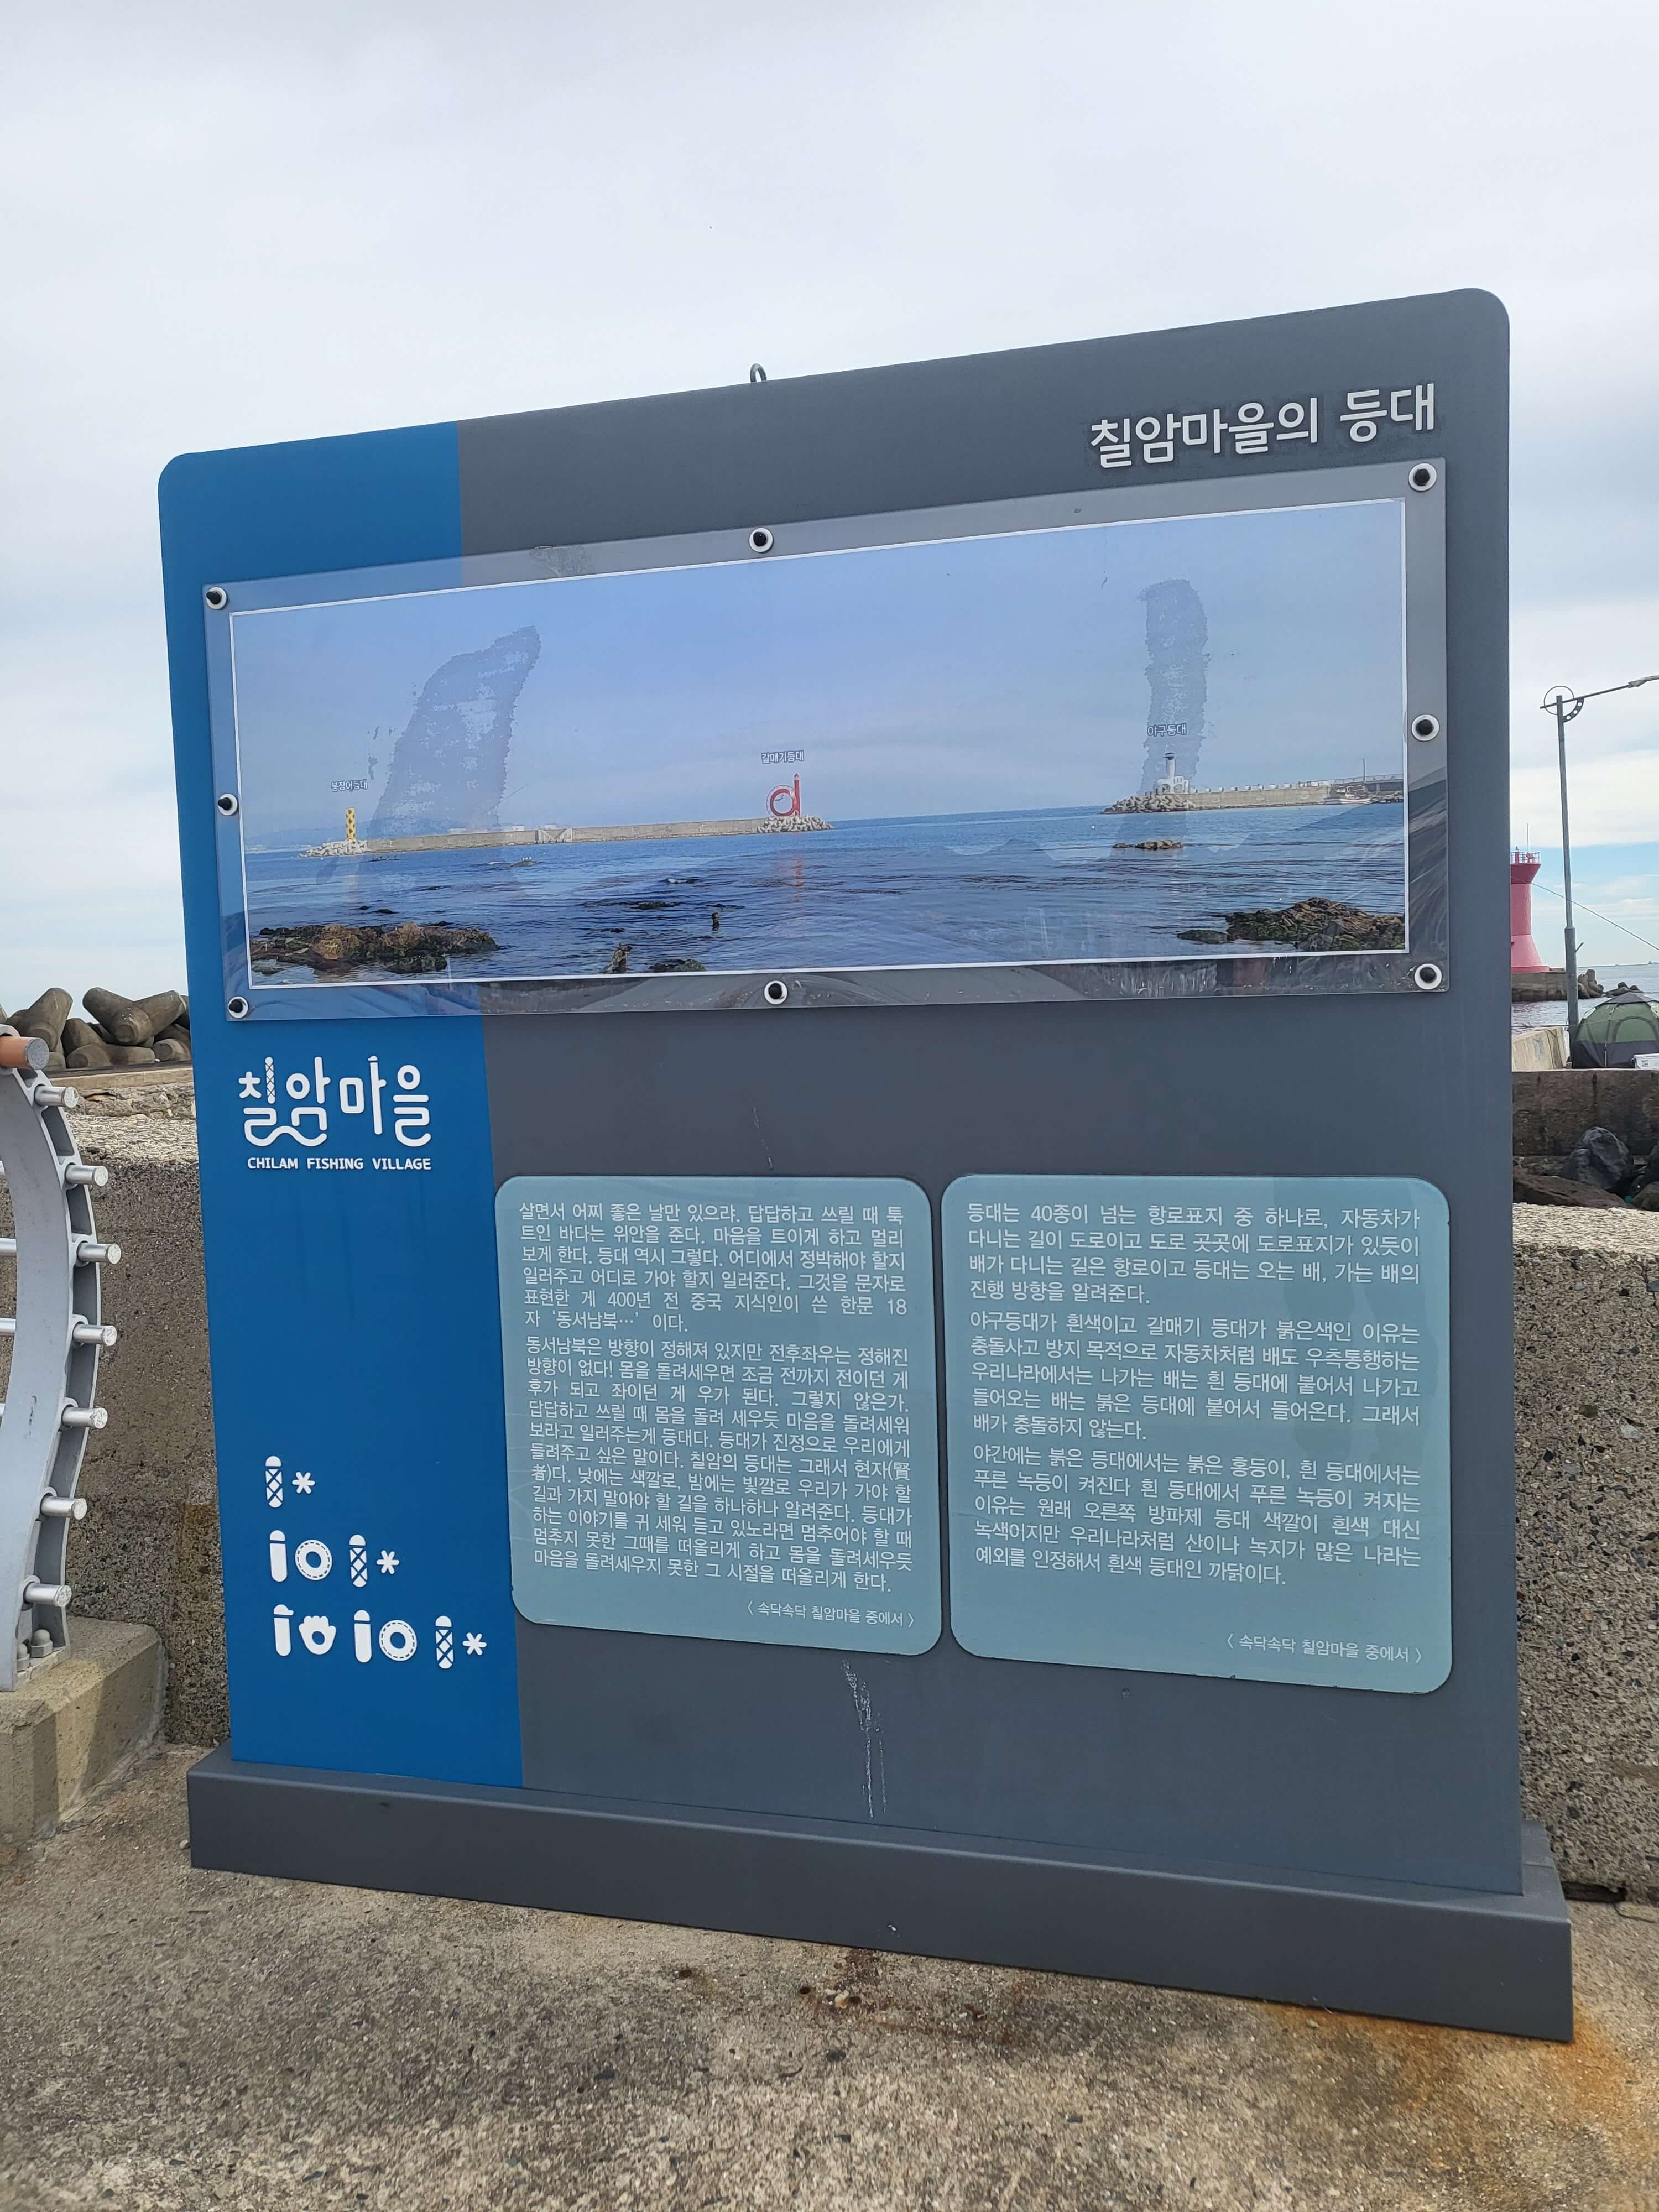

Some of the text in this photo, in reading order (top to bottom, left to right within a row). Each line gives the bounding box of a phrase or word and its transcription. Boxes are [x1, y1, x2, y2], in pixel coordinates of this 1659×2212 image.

[1091, 383, 1435, 469] 칠암마을의 등대
[1147, 723, 1187, 737] 야구등대
[761, 750, 805, 764] 갈매기등대
[239, 1055, 432, 1147] 칠암마을
[247, 1157, 432, 1171] CHILAM FISHING VILLAGE
[519, 1202, 904, 1225] 살면서 어찌 좋은 날만 있으랴. 답답하고 쓰릴 때 툭
[967, 1203, 1420, 1229] 등대는 40종이 넘는 항로표지 중 하나로, 자동차가
[521, 1245, 905, 1271] 보게 한다. 등대 역시 그렇다. 어디에서 정박해야 할지
[968, 1228, 1418, 1257] 다니는 길이 도로이고 도로 곳곳에 도로표지가 있듯이
[523, 1266, 906, 1293] 일러주고 어디로 가야 할지 일러준다. 그것을 문자로
[969, 1254, 1418, 1284] 배가 다니는 길은 항로이고 등대는 오는 배, 가는 배의
[970, 1280, 1150, 1304] 진행 방향을 알려준다.
[970, 1310, 1420, 1344] 야구등대가 흰색이고 갈매기 등대가 붉은색인 이유는
[525, 1335, 908, 1366] 동서남북은 방향이 정해져 있지만 전후좌우는 정해진
[971, 1335, 1420, 1371] 충돌사고 방지 목적으로 자동차처럼 배도 우측통행하는
[528, 1378, 909, 1412] 후가 되고 좌이던 게 우가 된다. 그렇지 않은가.
[971, 1361, 1421, 1398] 우리나라에서는 나가는 배는 흰 등대에 붙어서 나가고
[972, 1387, 1419, 1426] 들어오는 배는 붉은 등대에 붙어서 들어온다. 그래서
[529, 1421, 910, 1458] 보라고 일러주는게 등대다. 등대가 진정으로 우리에게
[973, 1413, 1146, 1440] 배가 충돌하지 않는다.
[973, 1443, 1421, 1485] 야간에는 붉은 등대에서는 붉은 홍등이, 흰 등대에서는
[532, 1485, 912, 1526] 길과 가지 말아야 할 길을 하나하나 알려준다. 등대가
[975, 1495, 1420, 1540] 이유는 원래 오른쪽 방파제 등대 색깔이 흰색 대신
[534, 1527, 913, 1571] 멈추지 못한 그때를 떠올리게 하고 몸을 돌려세우듯
[975, 1546, 1286, 1585] 예외를 인정해서 흰색 등대인 까닭이다.
[534, 1548, 891, 1592] 마음을 돌려세우지 못한 그 시절을 떠올리게 한다.
